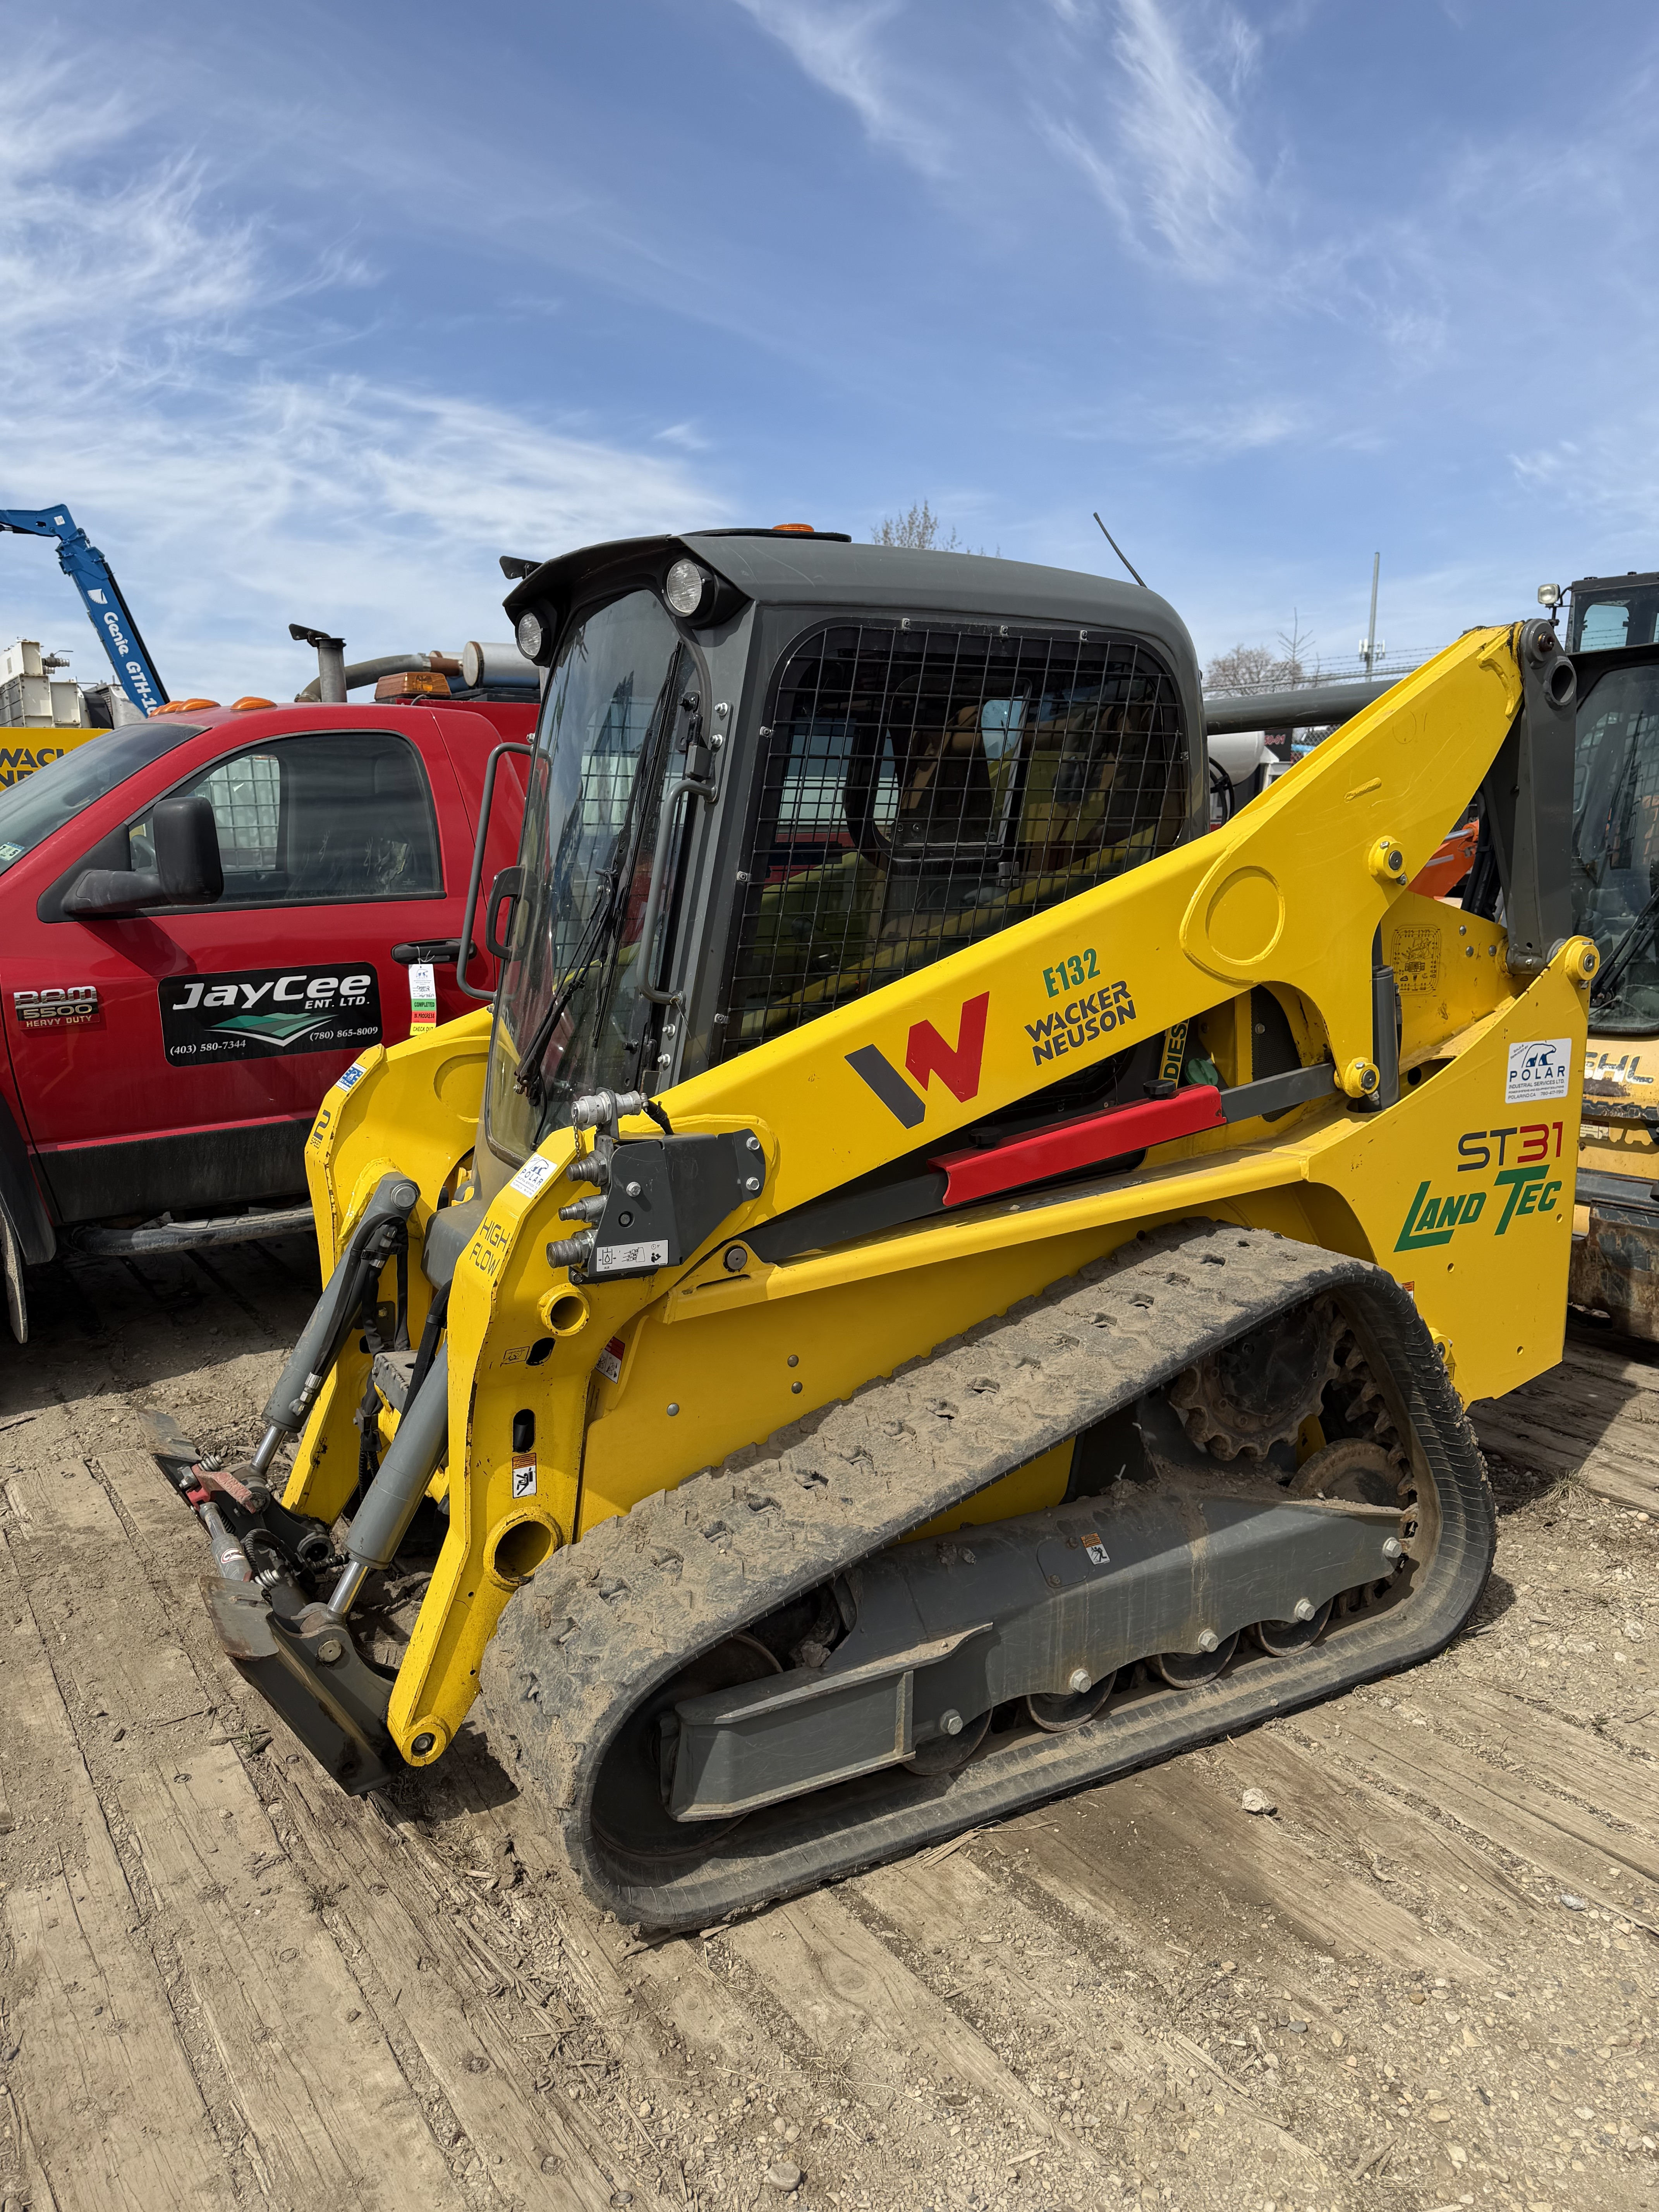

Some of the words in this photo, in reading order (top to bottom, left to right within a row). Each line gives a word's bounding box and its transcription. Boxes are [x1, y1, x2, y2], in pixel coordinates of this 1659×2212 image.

[104, 612, 129, 657] Genie
[1042, 948, 1101, 998] E132
[14, 986, 97, 1006] RAM
[172, 975, 371, 1010] JayCee
[305, 999, 335, 1009] ENT.
[340, 996, 370, 1007] LTD.
[24, 1005, 92, 1019] 5500
[26, 1018, 61, 1028] HEAVY
[66, 1015, 92, 1024] DUTY
[1024, 980, 1132, 1042] WACKER
[170, 1044, 197, 1056] (403)
[200, 1039, 246, 1052] 580-7344
[310, 1030, 334, 1041] (780)
[337, 1027, 378, 1037] 865-8009
[1032, 1000, 1137, 1067] NEUSON
[1163, 1020, 1188, 1079] DIES
[1509, 1066, 1565, 1082] POLAR
[313, 1109, 331, 1141] 2
[1457, 1121, 1563, 1172] ST31
[520, 1169, 543, 1186] POLAR
[480, 1217, 510, 1252] HIGH
[469, 1242, 500, 1277] FLOW
